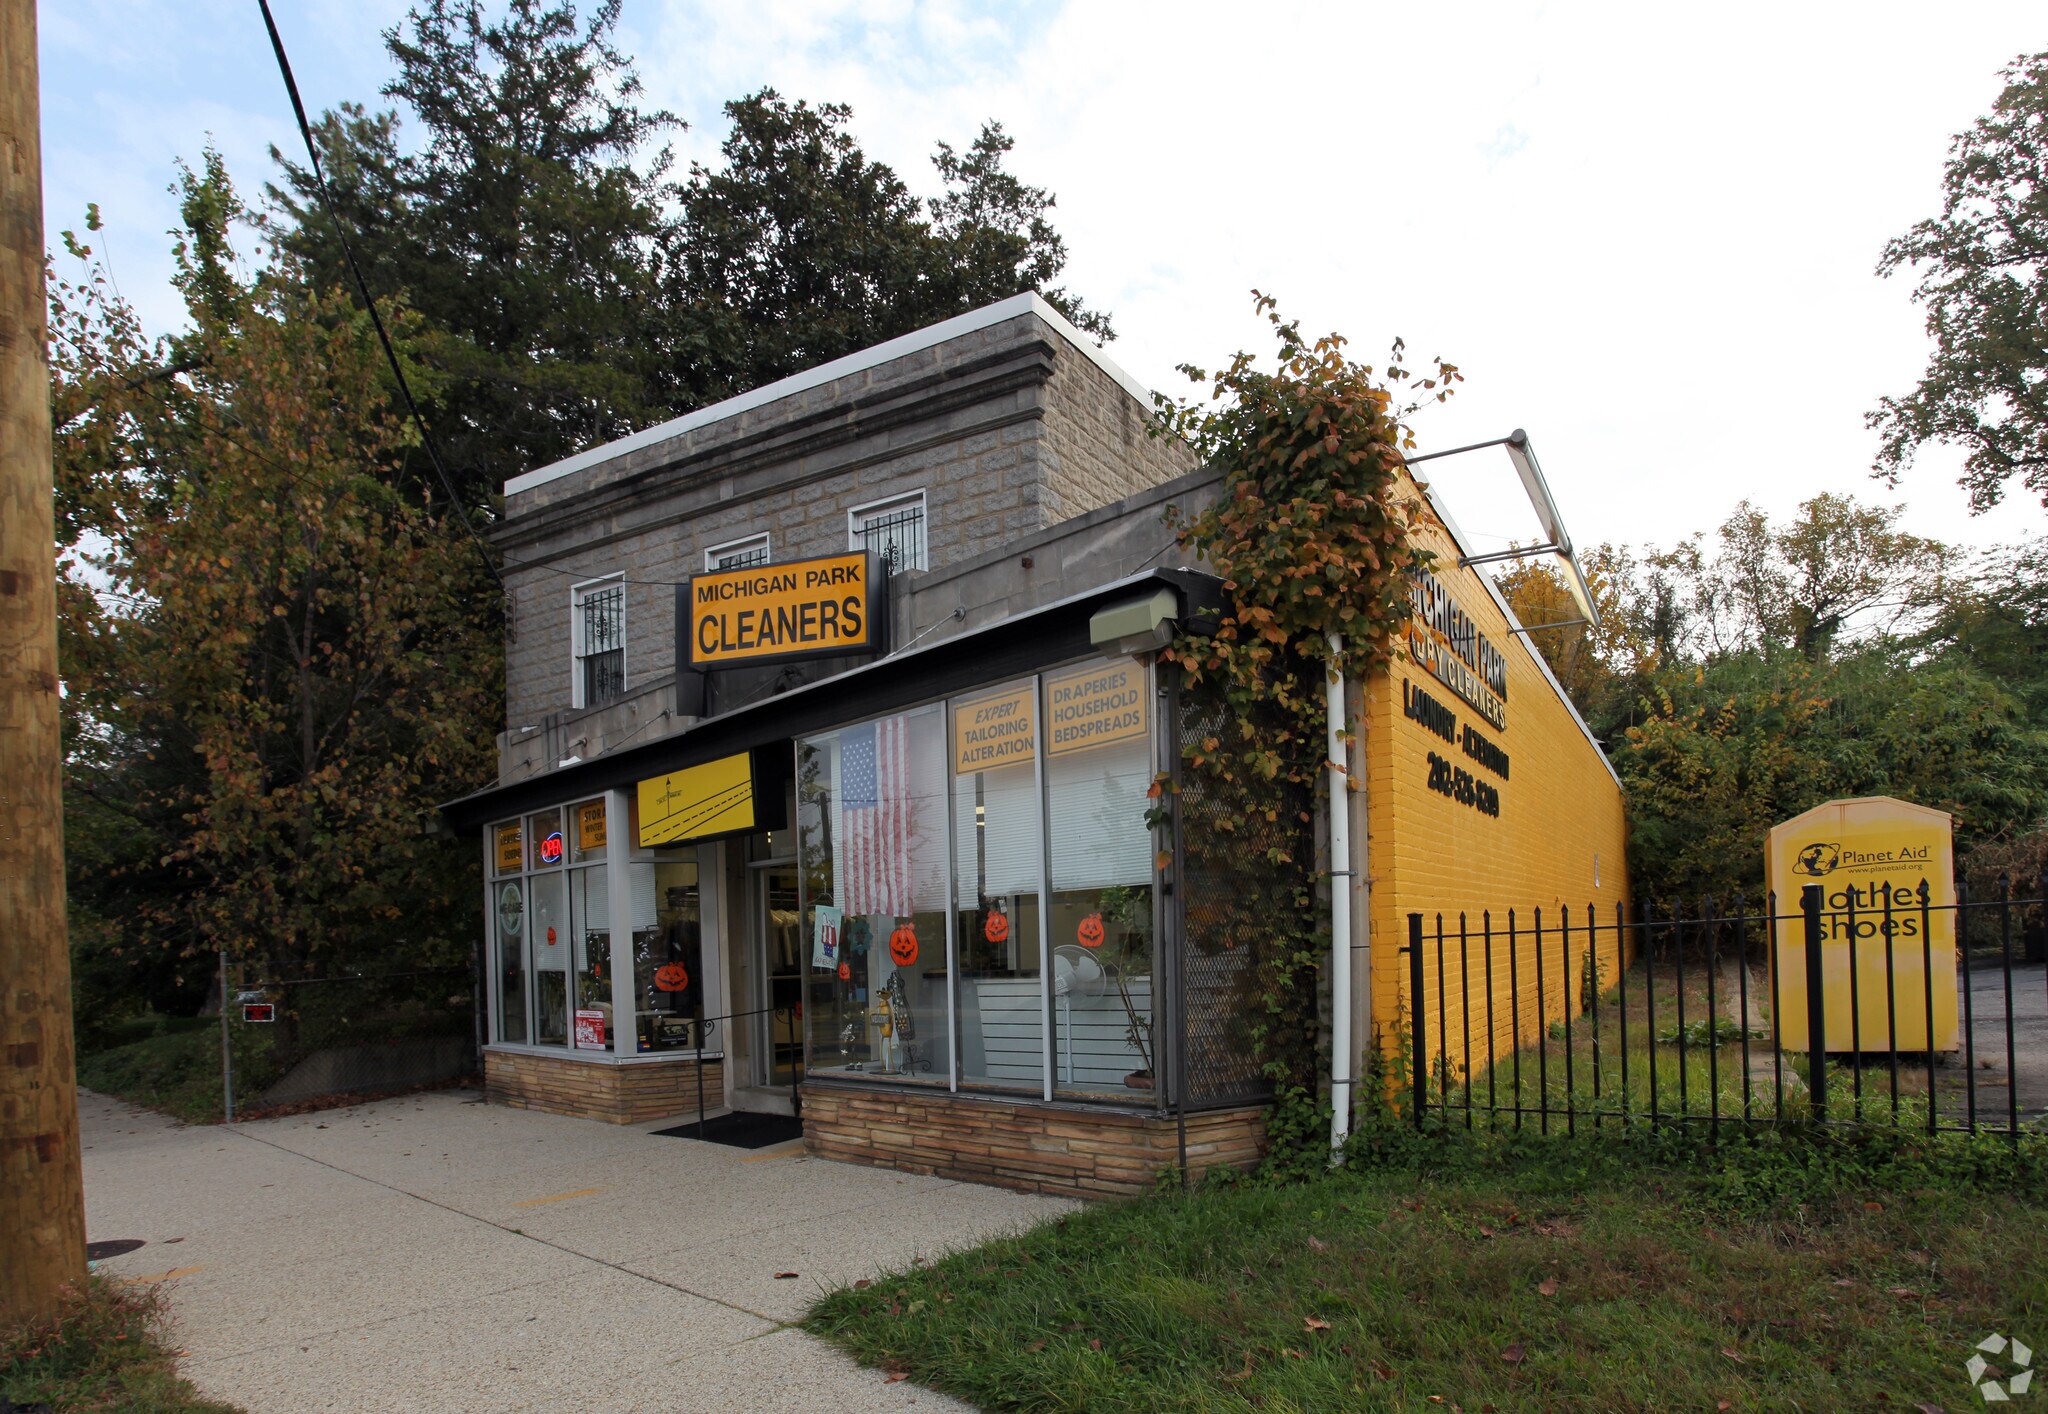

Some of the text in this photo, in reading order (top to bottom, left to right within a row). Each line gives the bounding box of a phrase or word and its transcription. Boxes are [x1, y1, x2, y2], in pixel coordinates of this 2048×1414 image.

[698, 565, 861, 603] MICHIGAN PARK
[698, 596, 862, 655] CLEANERS
[1409, 566, 1508, 702] ICHIGAN PARK
[1053, 671, 1127, 704] DRAPERIES
[1447, 657, 1505, 730] CLEANERS
[975, 700, 1020, 724] EXPERT
[1054, 690, 1139, 723] HOUSEHOLD
[965, 718, 1029, 745] TAILORING
[1054, 710, 1140, 744] BEDSPREADS
[1403, 678, 1509, 781] LAUNDRY ALTERATION
[961, 736, 1035, 764] ALTERATION
[585, 822, 604, 834] WINTER
[541, 839, 562, 857] OPEN
[1843, 846, 1928, 863] Planet Aid
[1848, 864, 1923, 874] www.planetaid.org
